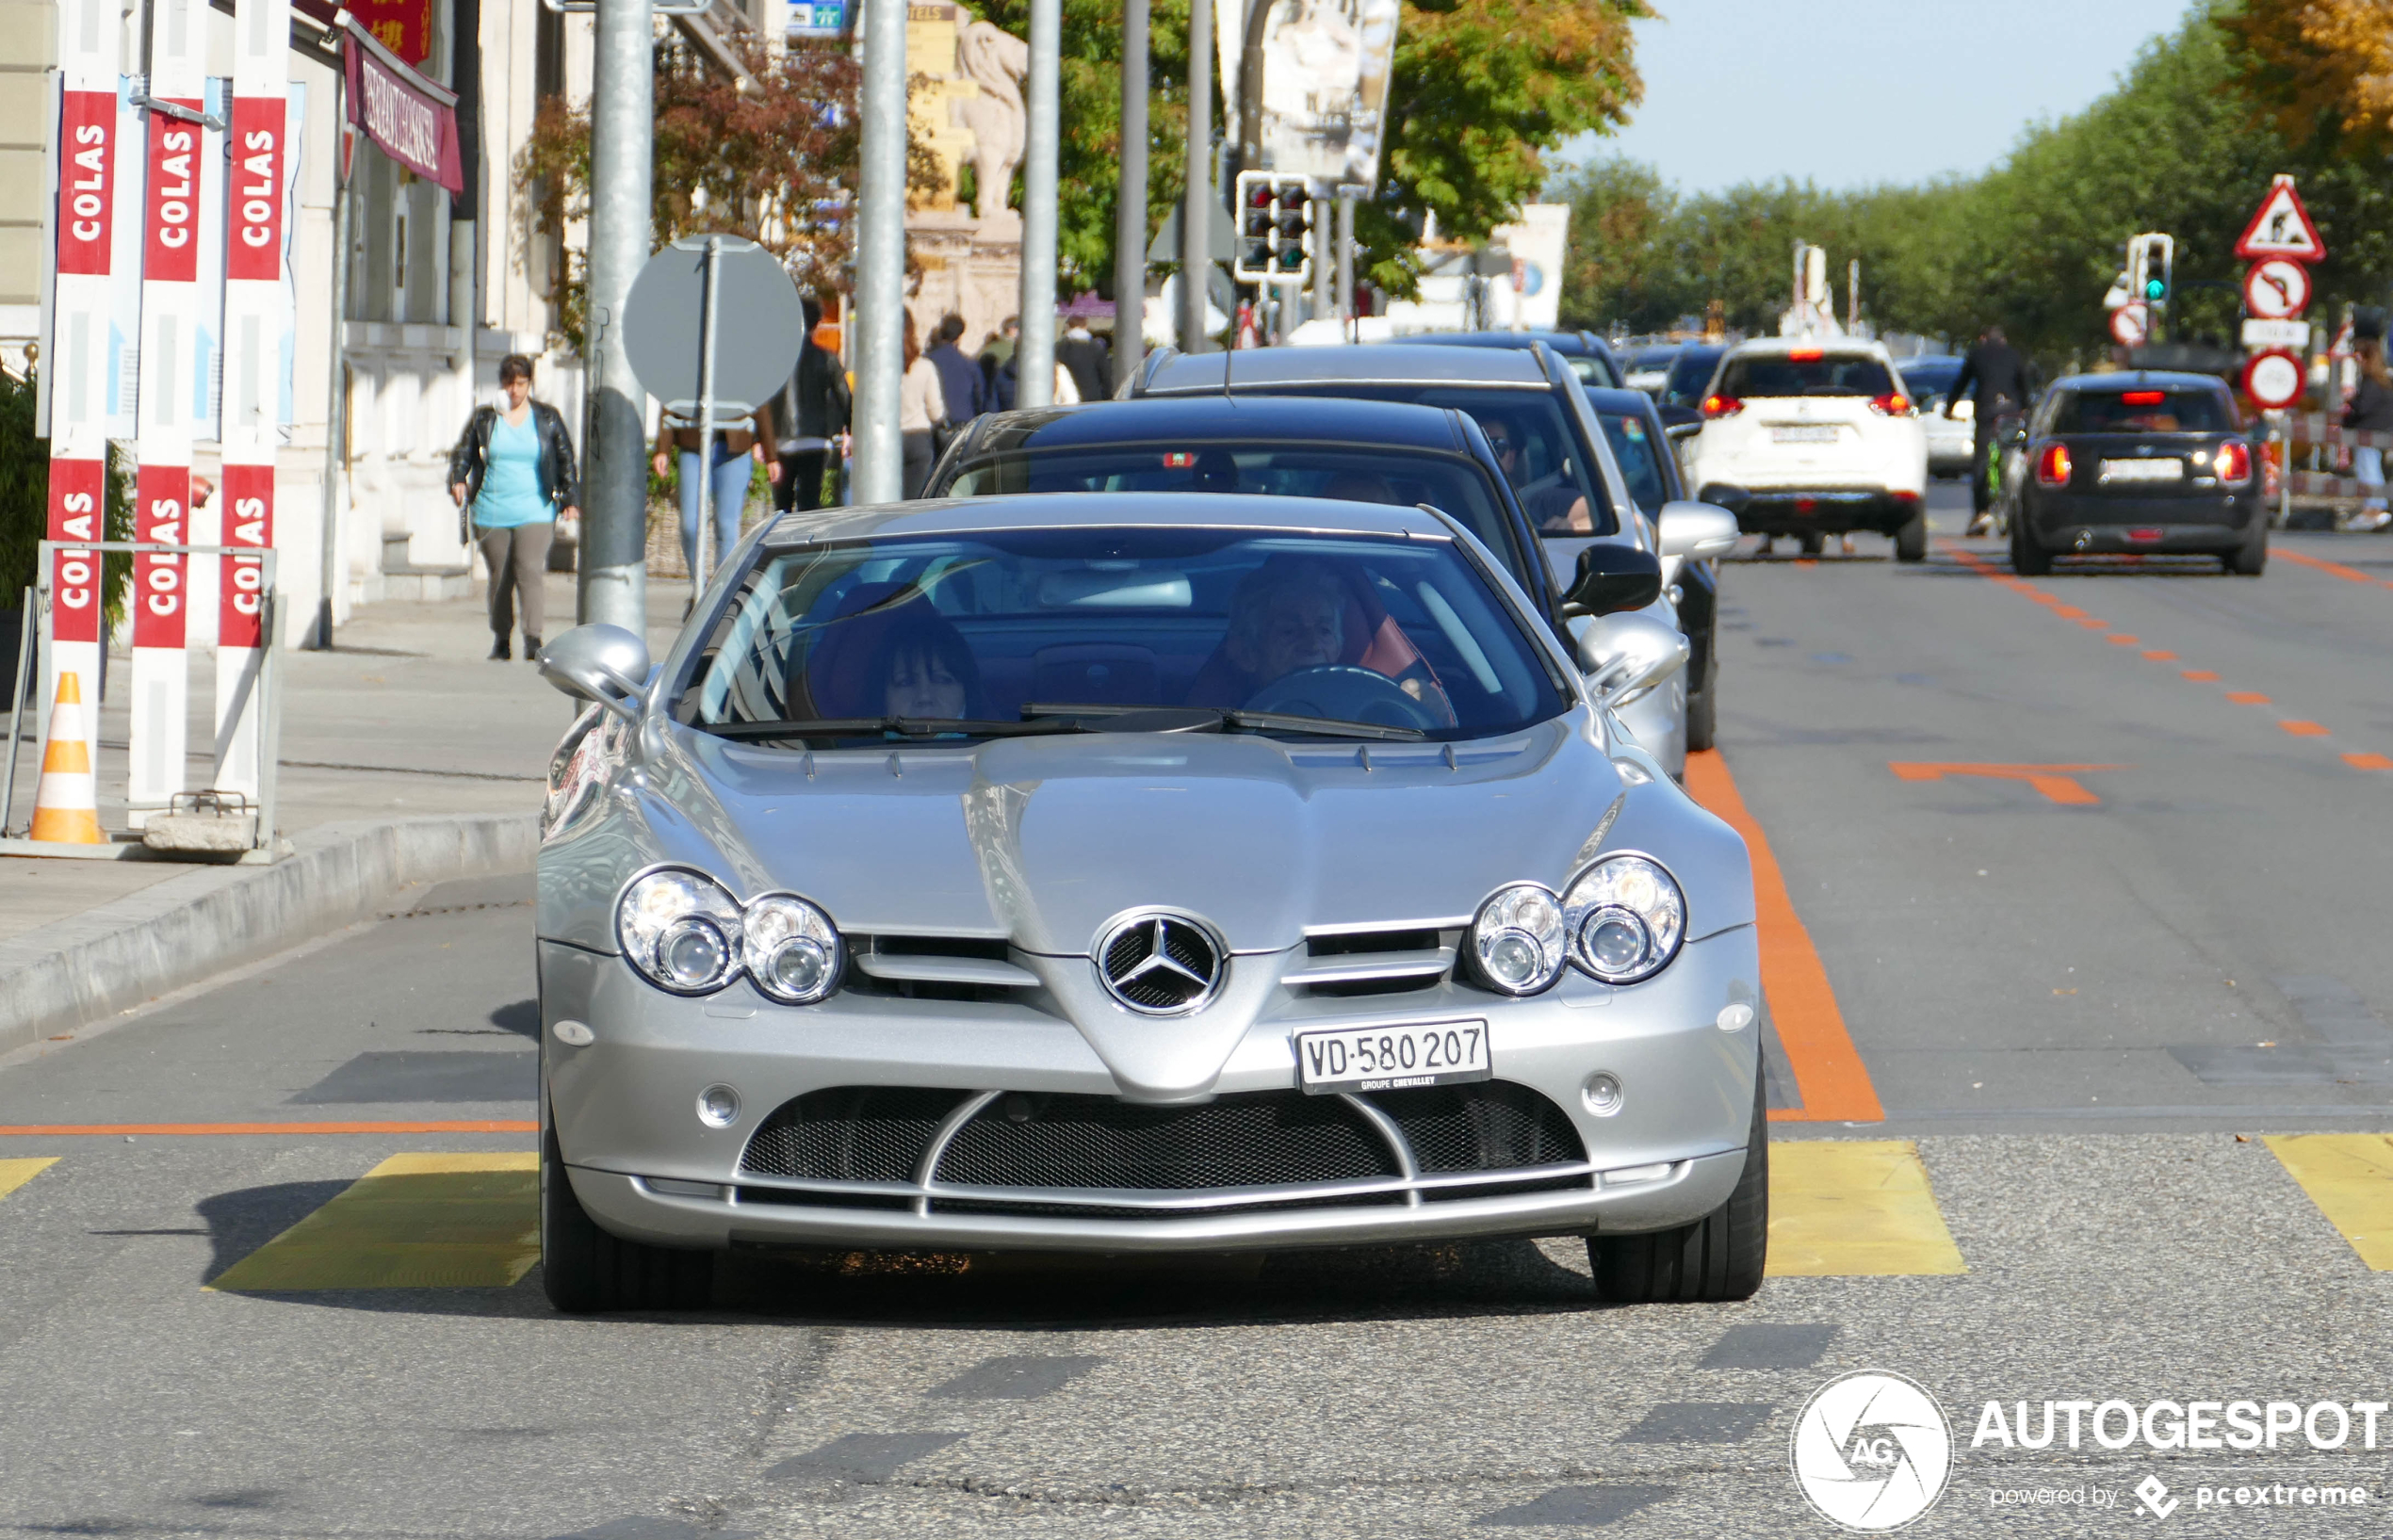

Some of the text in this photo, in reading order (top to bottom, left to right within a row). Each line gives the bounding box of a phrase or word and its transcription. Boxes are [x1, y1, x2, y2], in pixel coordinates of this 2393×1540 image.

[908, 6, 942, 21] TELS
[73, 124, 105, 242] COLAS
[159, 131, 192, 248] COLAS
[241, 130, 274, 248] COLAS
[60, 492, 93, 609] COLAS
[148, 499, 181, 616] COLAS
[1360, 1076, 1436, 1091] GROUPE CHEVALLEY
